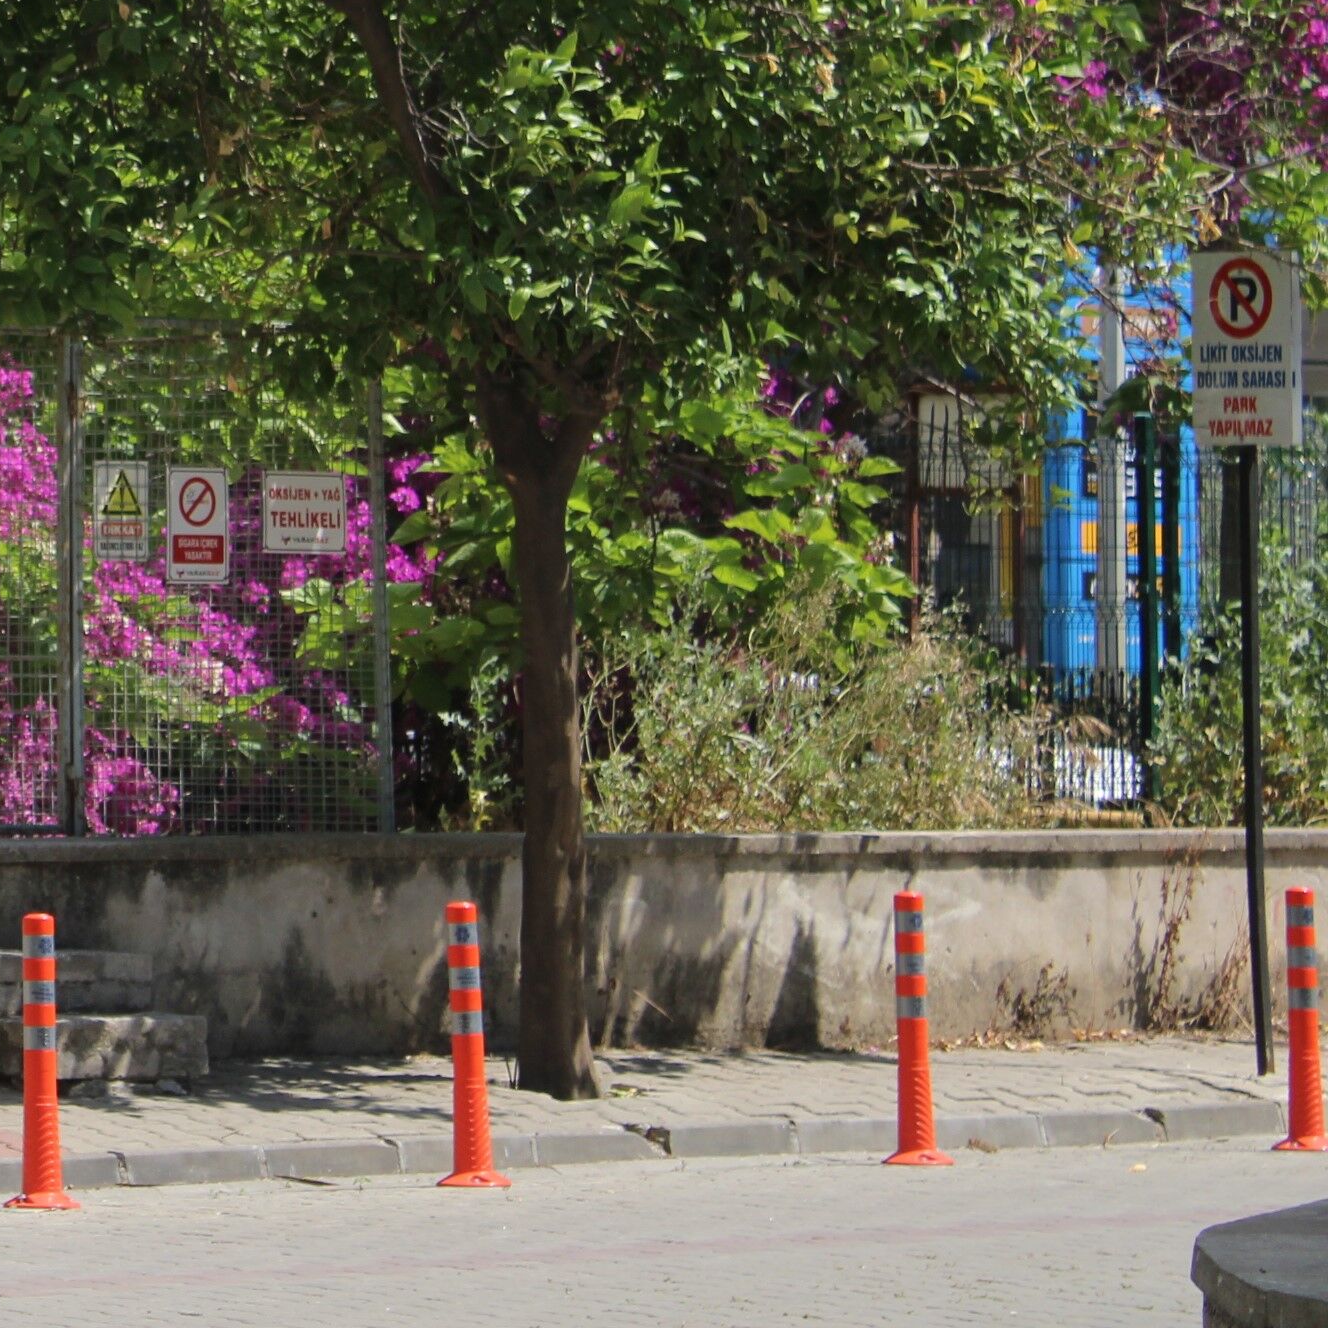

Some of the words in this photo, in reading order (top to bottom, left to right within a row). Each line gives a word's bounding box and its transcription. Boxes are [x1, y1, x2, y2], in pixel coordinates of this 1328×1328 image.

[1200, 341, 1228, 363] LİKİT
[1231, 341, 1282, 363] OKSİJEN
[1197, 370, 1238, 388] DOLUM
[1242, 370, 1286, 388] SAHASI
[1223, 396, 1257, 414] PARK
[1208, 418, 1274, 438] YAPILMAZ
[268, 486, 311, 501] OKSİJEN
[321, 487, 341, 502] YAĞ
[270, 508, 341, 529] TEHLİKELİ
